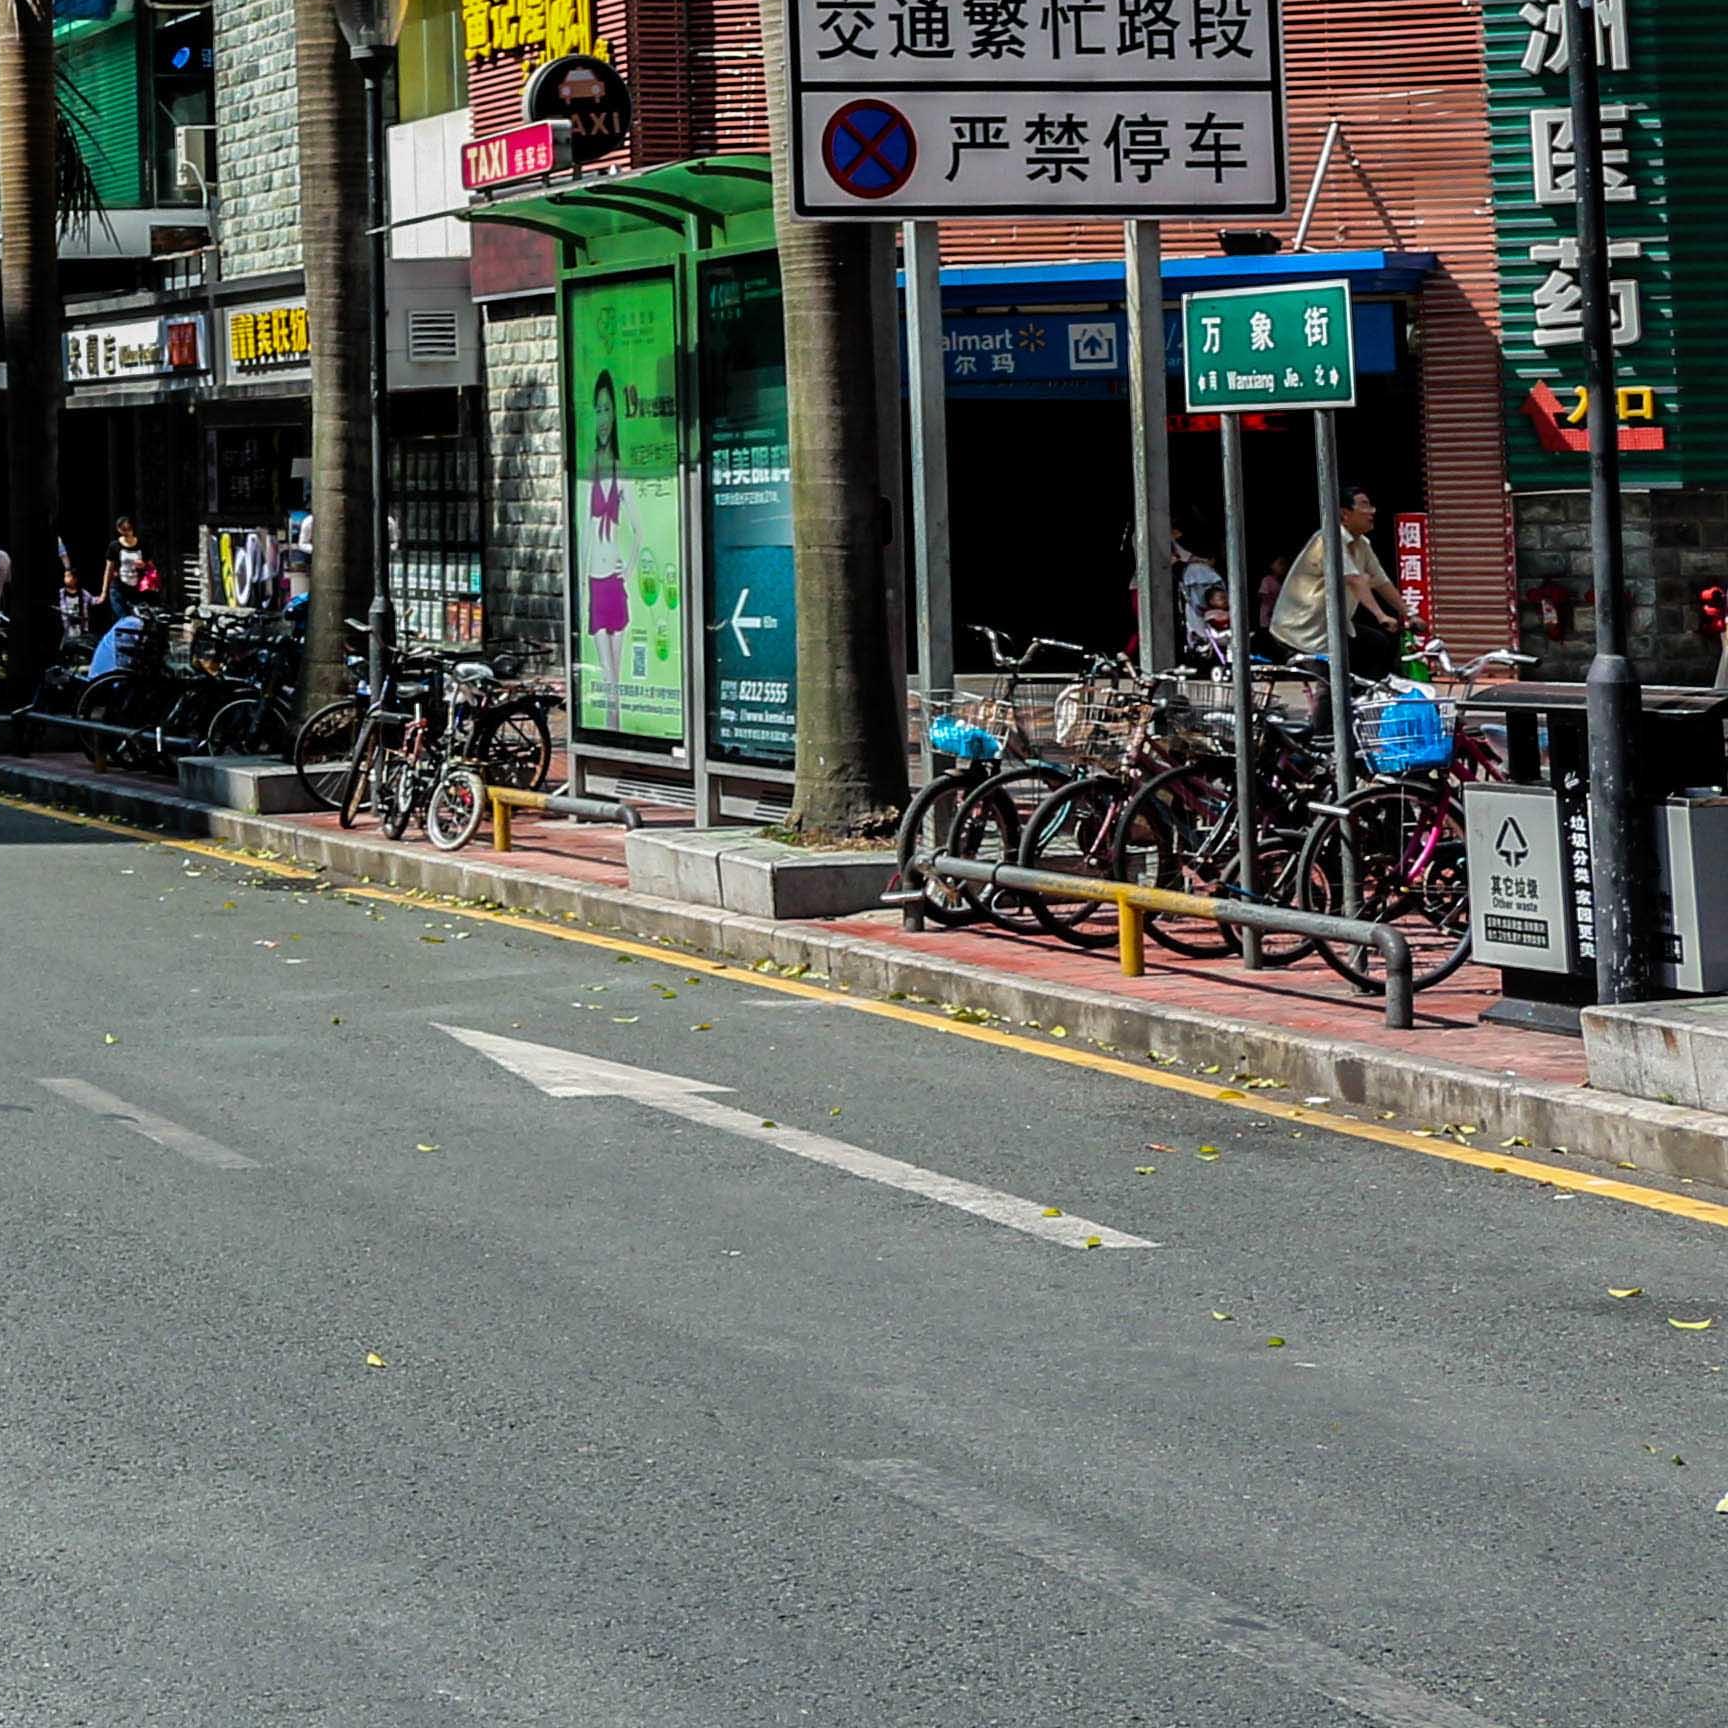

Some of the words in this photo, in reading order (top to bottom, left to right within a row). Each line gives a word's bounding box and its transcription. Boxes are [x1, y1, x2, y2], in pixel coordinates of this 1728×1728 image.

[466, 139, 508, 185] TAXI
[945, 112, 1250, 186] 严禁停车
[1200, 306, 1329, 354] 万象街
[1226, 369, 1275, 393] Wanxiang
[1490, 874, 1539, 900] 其它垃圾
